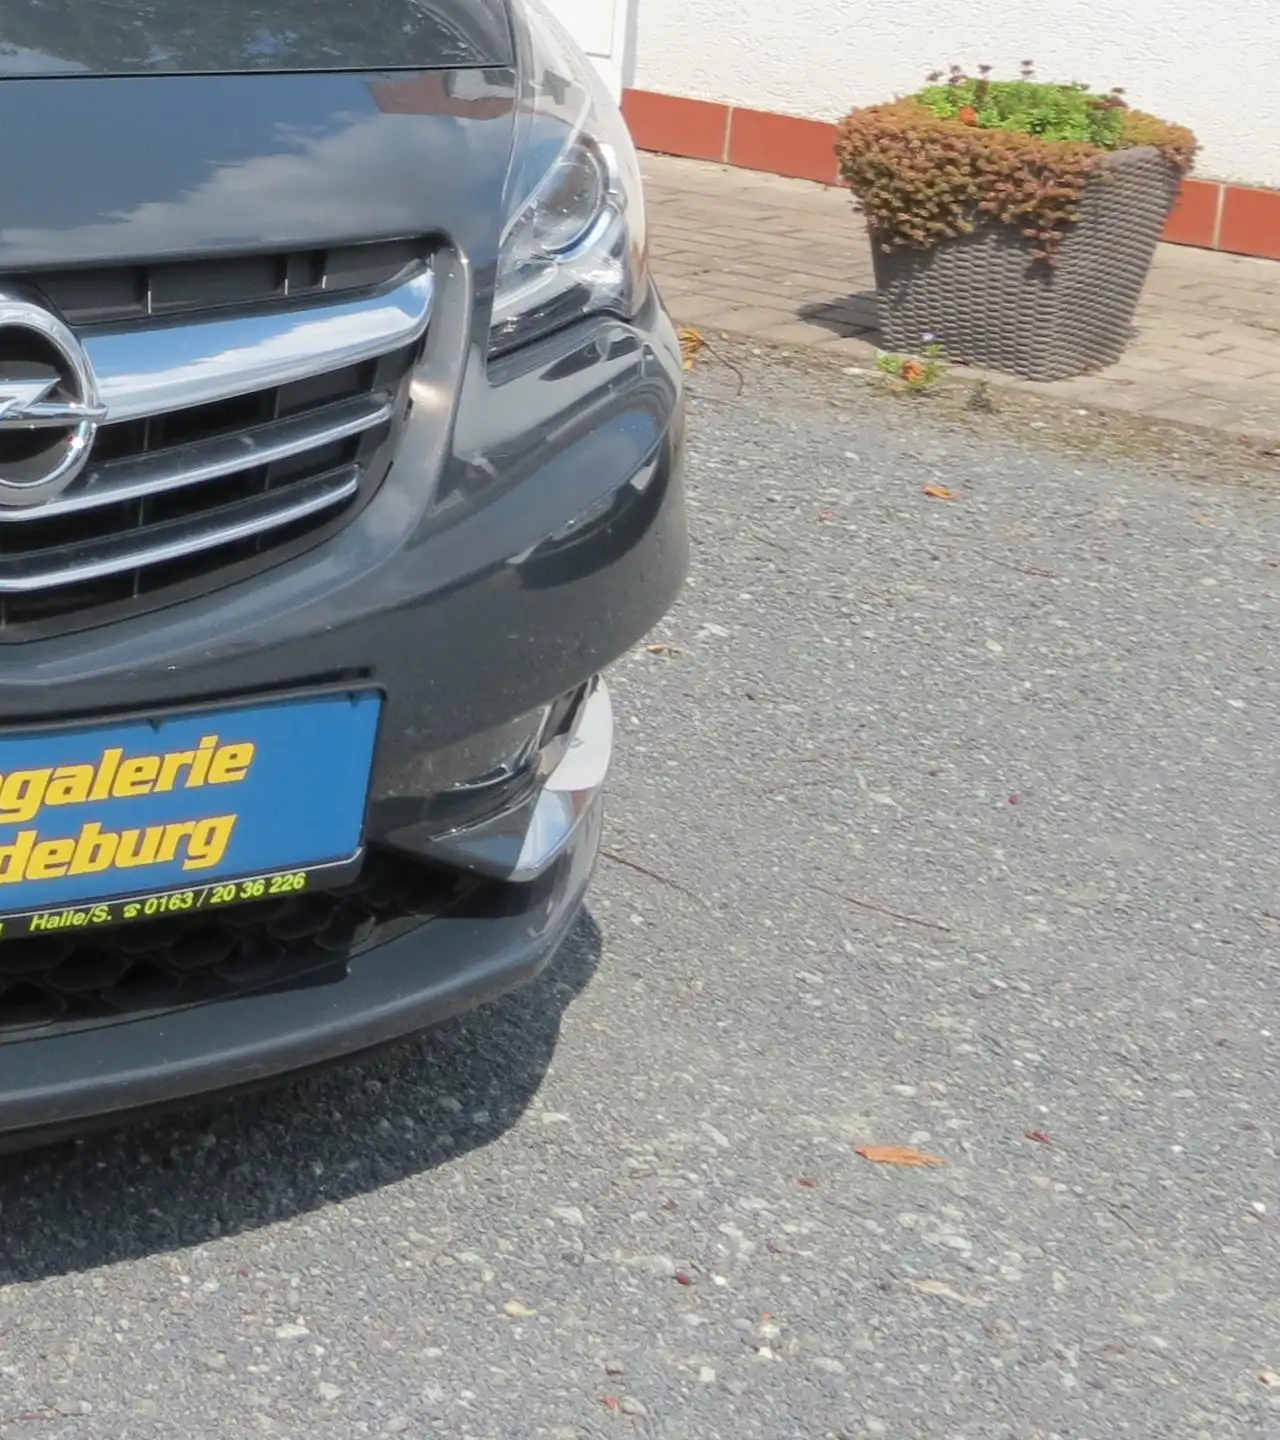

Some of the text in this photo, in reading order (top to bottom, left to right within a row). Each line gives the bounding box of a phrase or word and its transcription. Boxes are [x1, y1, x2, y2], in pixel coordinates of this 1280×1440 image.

[30, 906, 112, 931] Halle/S.
[144, 892, 193, 915] 0163
[210, 884, 236, 904] 20
[241, 878, 265, 898] 36
[268, 872, 306, 894] 226
